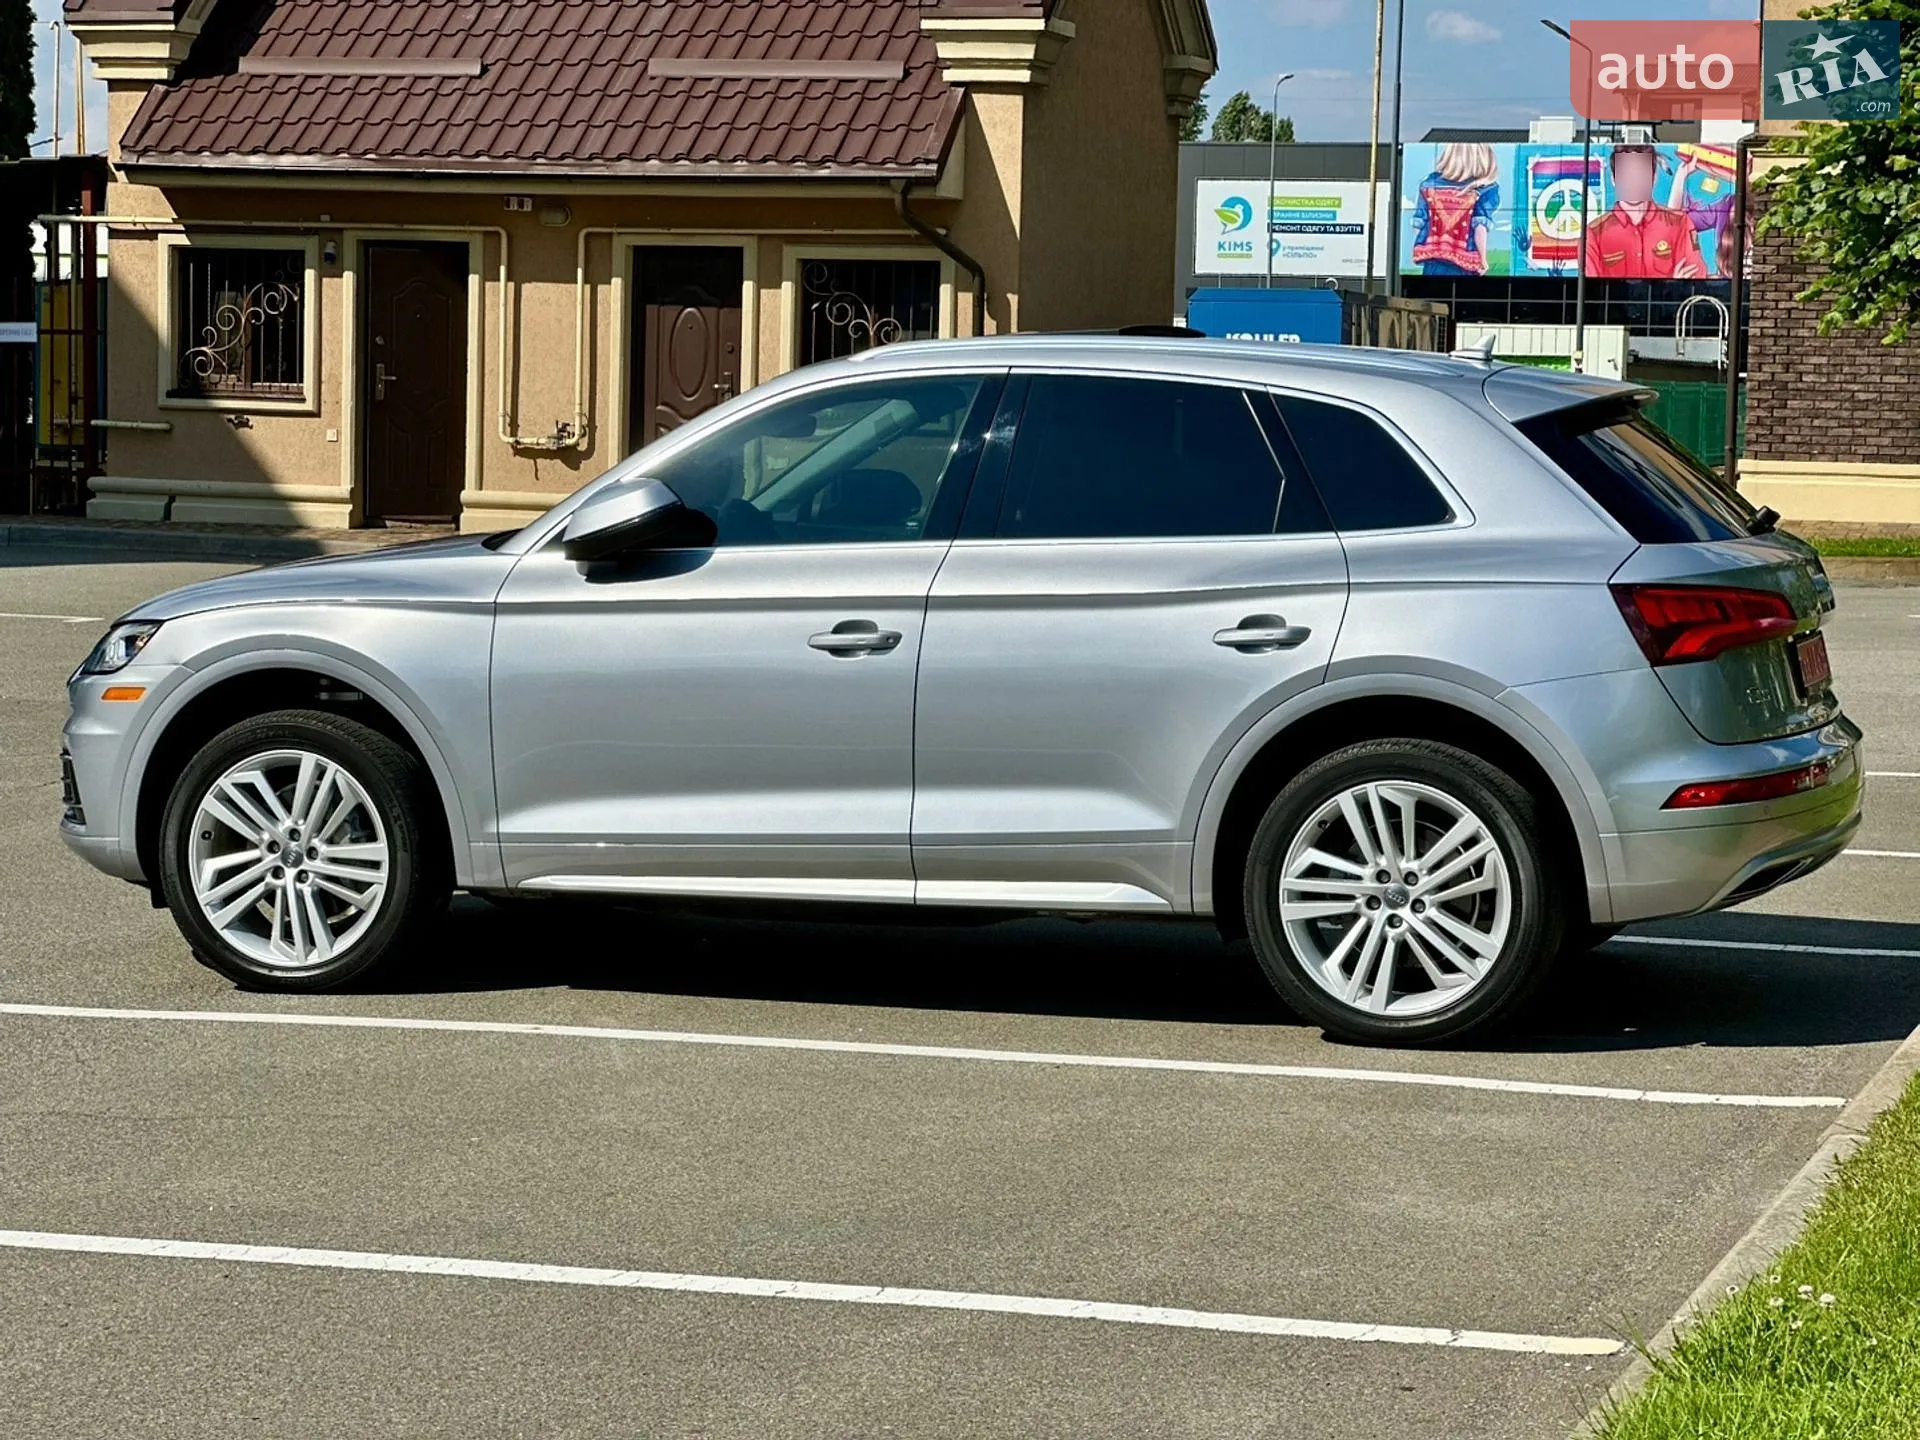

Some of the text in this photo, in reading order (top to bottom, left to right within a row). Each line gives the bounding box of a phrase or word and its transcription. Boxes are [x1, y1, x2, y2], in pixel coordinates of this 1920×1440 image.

[1301, 225, 1324, 233] ОДЯГУ
[1335, 225, 1361, 233] ВЗУТТЯ
[1217, 240, 1253, 252] KIMS
